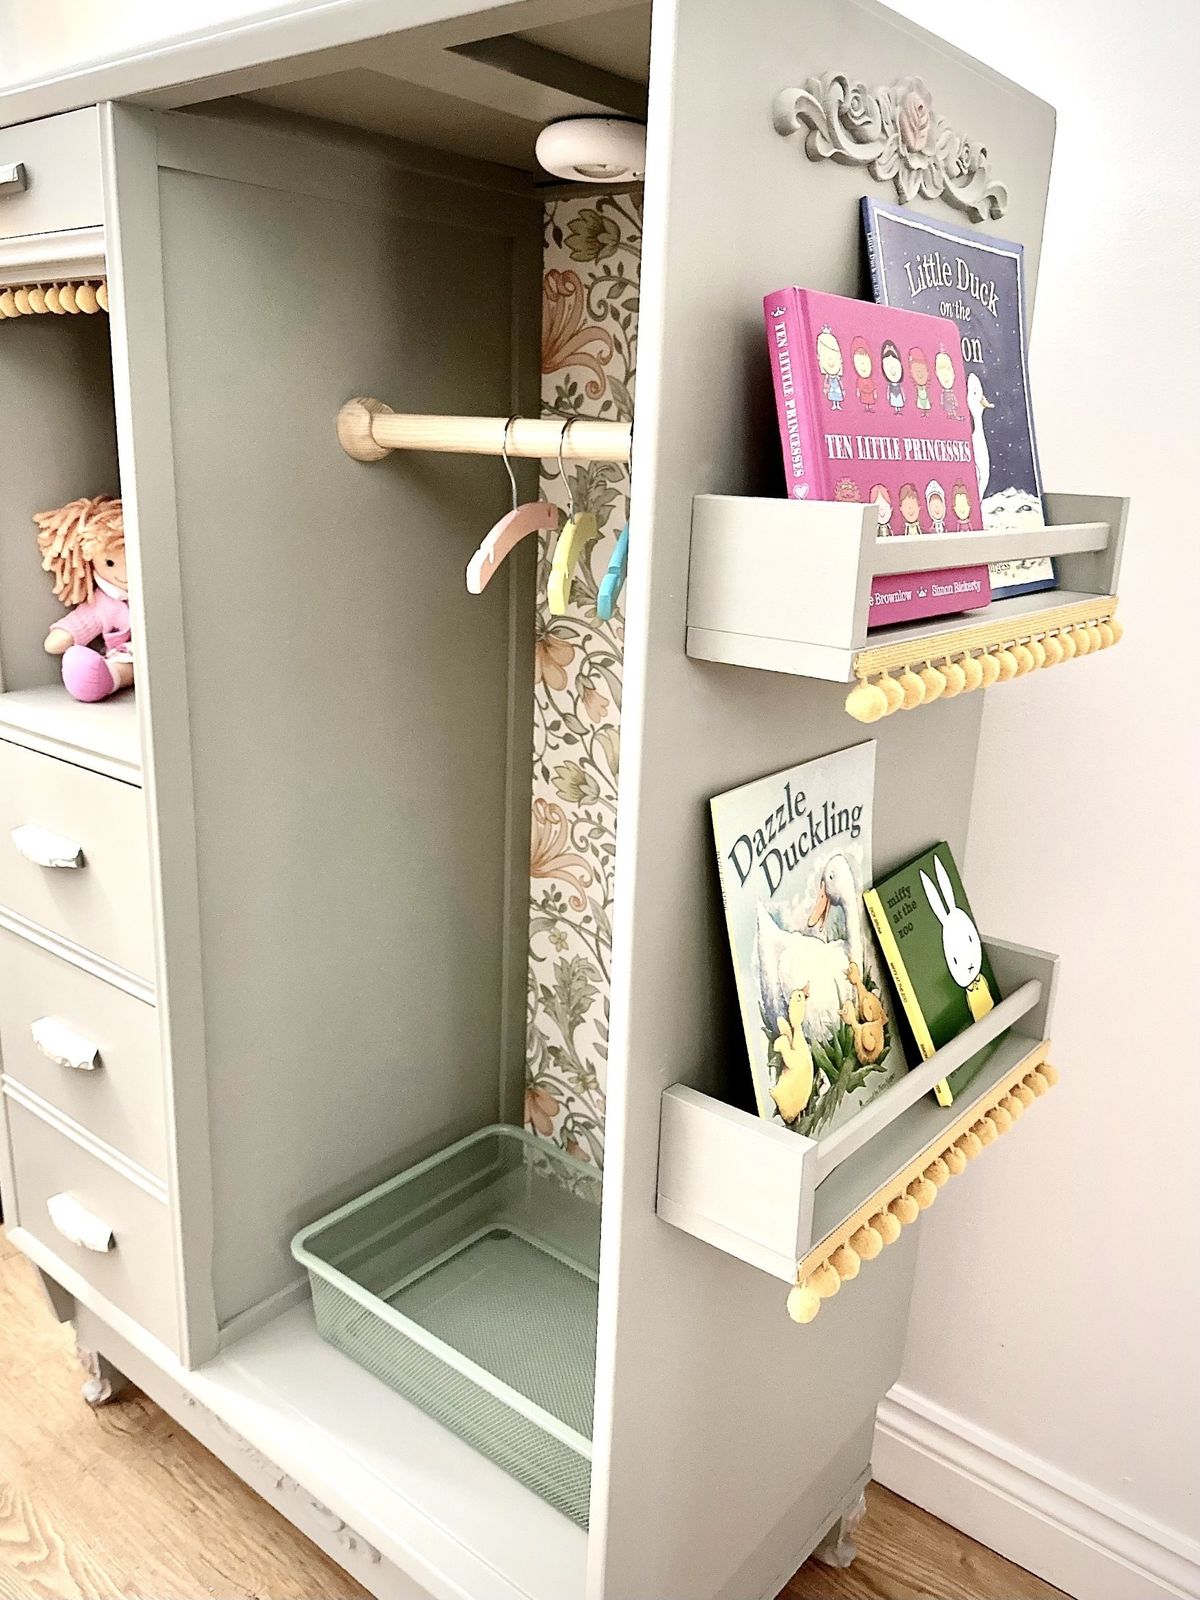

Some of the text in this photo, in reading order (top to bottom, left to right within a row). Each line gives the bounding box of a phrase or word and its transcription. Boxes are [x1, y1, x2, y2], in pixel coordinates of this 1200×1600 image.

[904, 252, 999, 318] Little Duck
[940, 300, 971, 321] on the
[961, 336, 984, 363] on
[775, 322, 804, 478] TEN LITTLE PRINCESSES
[824, 434, 971, 462] TEN LITTLE PRINCESSES
[875, 589, 913, 605] Brownlow
[931, 583, 953, 597] Simon
[728, 781, 806, 888] Dazzle
[759, 801, 863, 898] Duckling
[887, 886, 911, 908] miffy
[893, 900, 917, 924] at the
[898, 922, 914, 939] zoo
